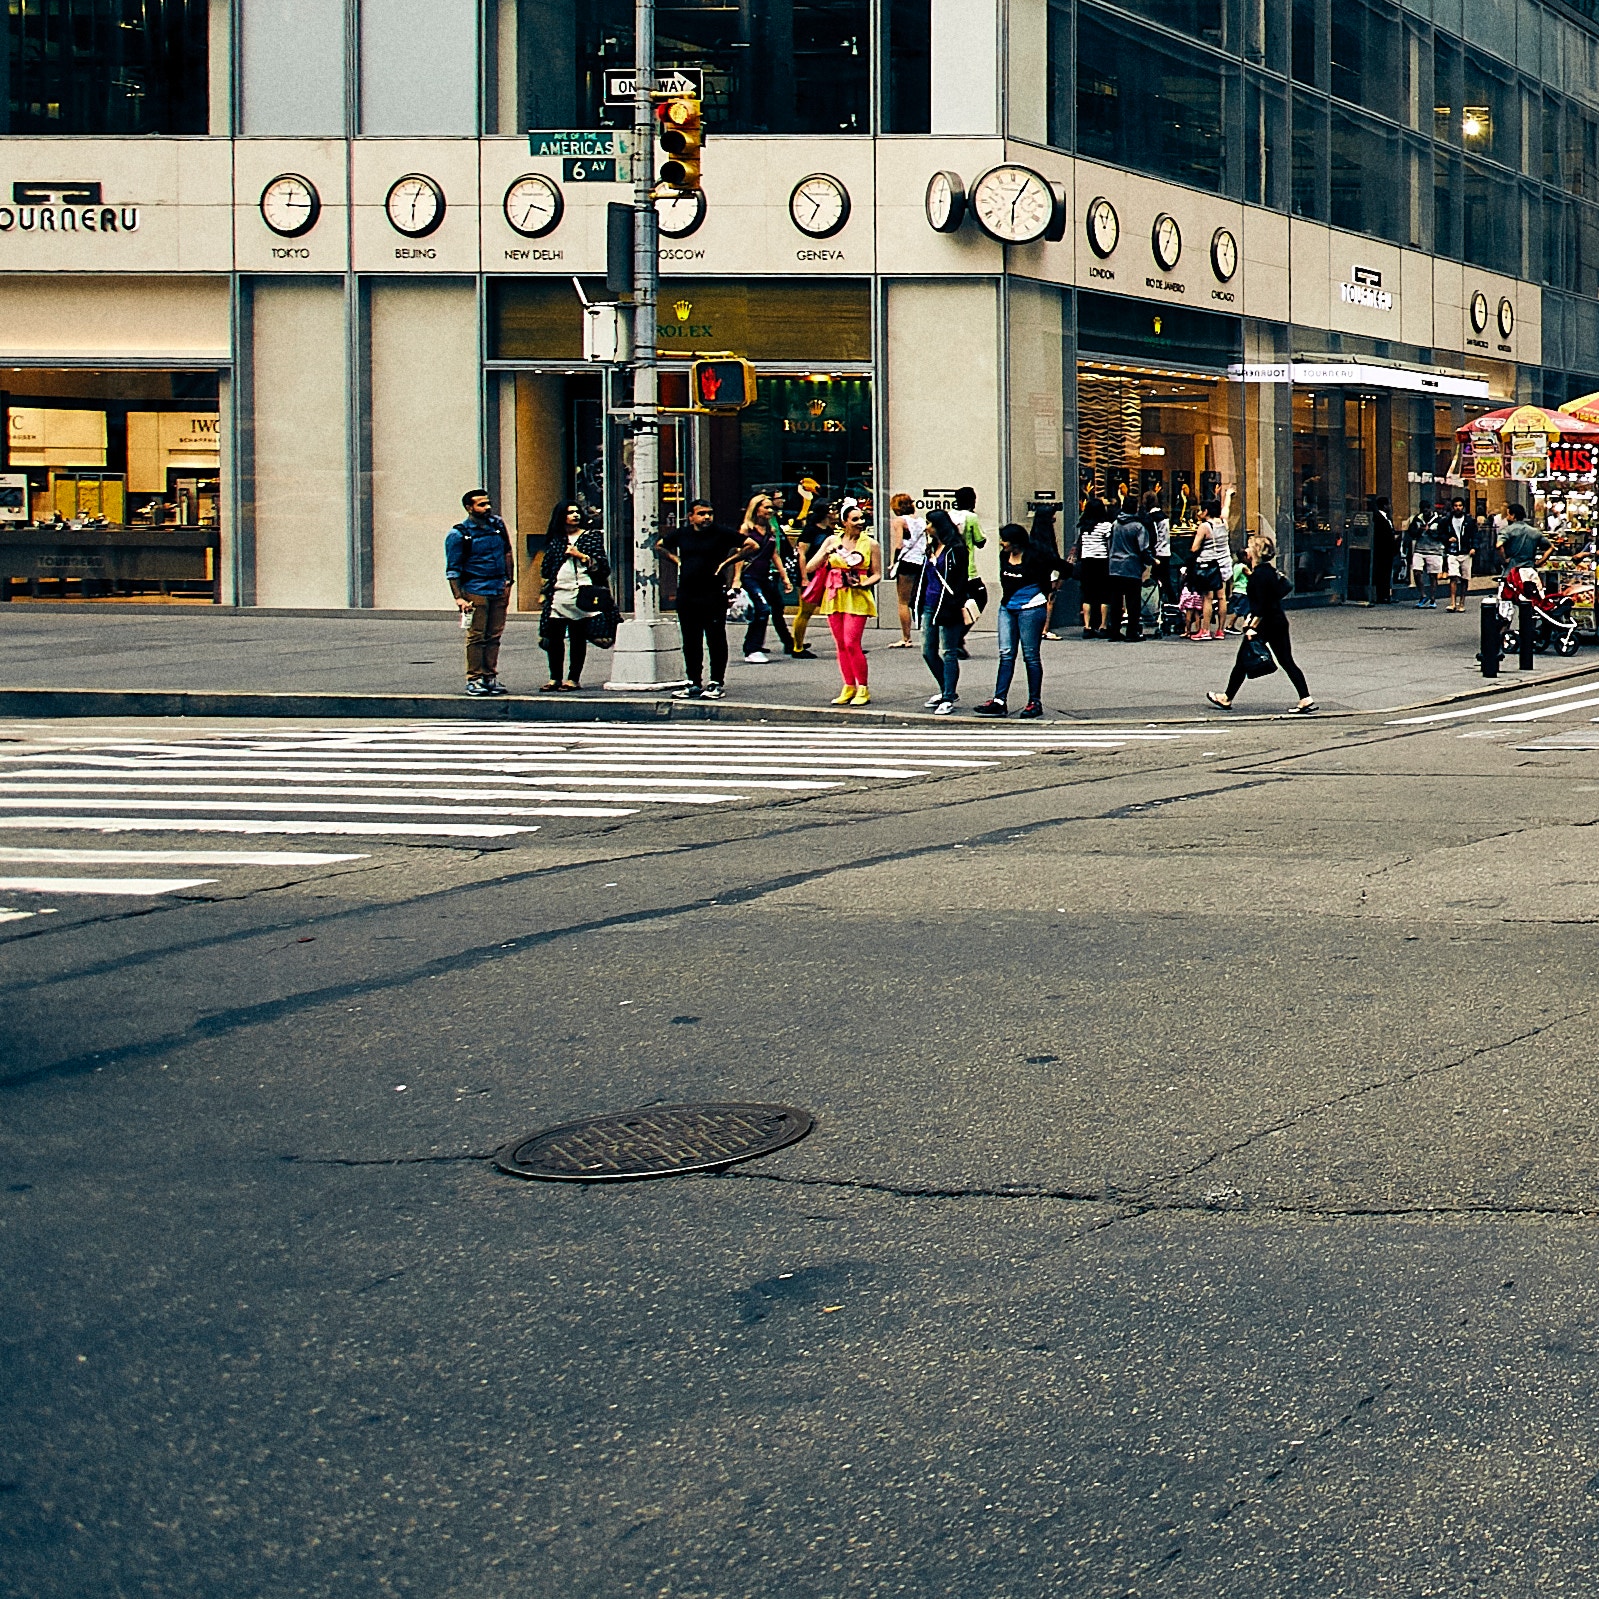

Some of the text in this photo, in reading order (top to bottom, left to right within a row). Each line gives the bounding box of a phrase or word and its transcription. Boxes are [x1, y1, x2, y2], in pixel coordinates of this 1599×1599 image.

[618, 80, 687, 93] ON WAY
[539, 141, 614, 155] AMERICAS
[572, 161, 606, 179] 6 AV
[271, 248, 310, 259] TOKYO
[395, 248, 437, 259] BEIJING
[504, 249, 564, 260] NEW DELHI
[658, 249, 705, 260] OSCOW
[796, 250, 845, 261] GENEVA
[1089, 267, 1115, 280] LONDON
[1211, 290, 1235, 302] CHICAGO
[783, 419, 847, 433] ROLEX
[912, 500, 959, 510] OURNE
